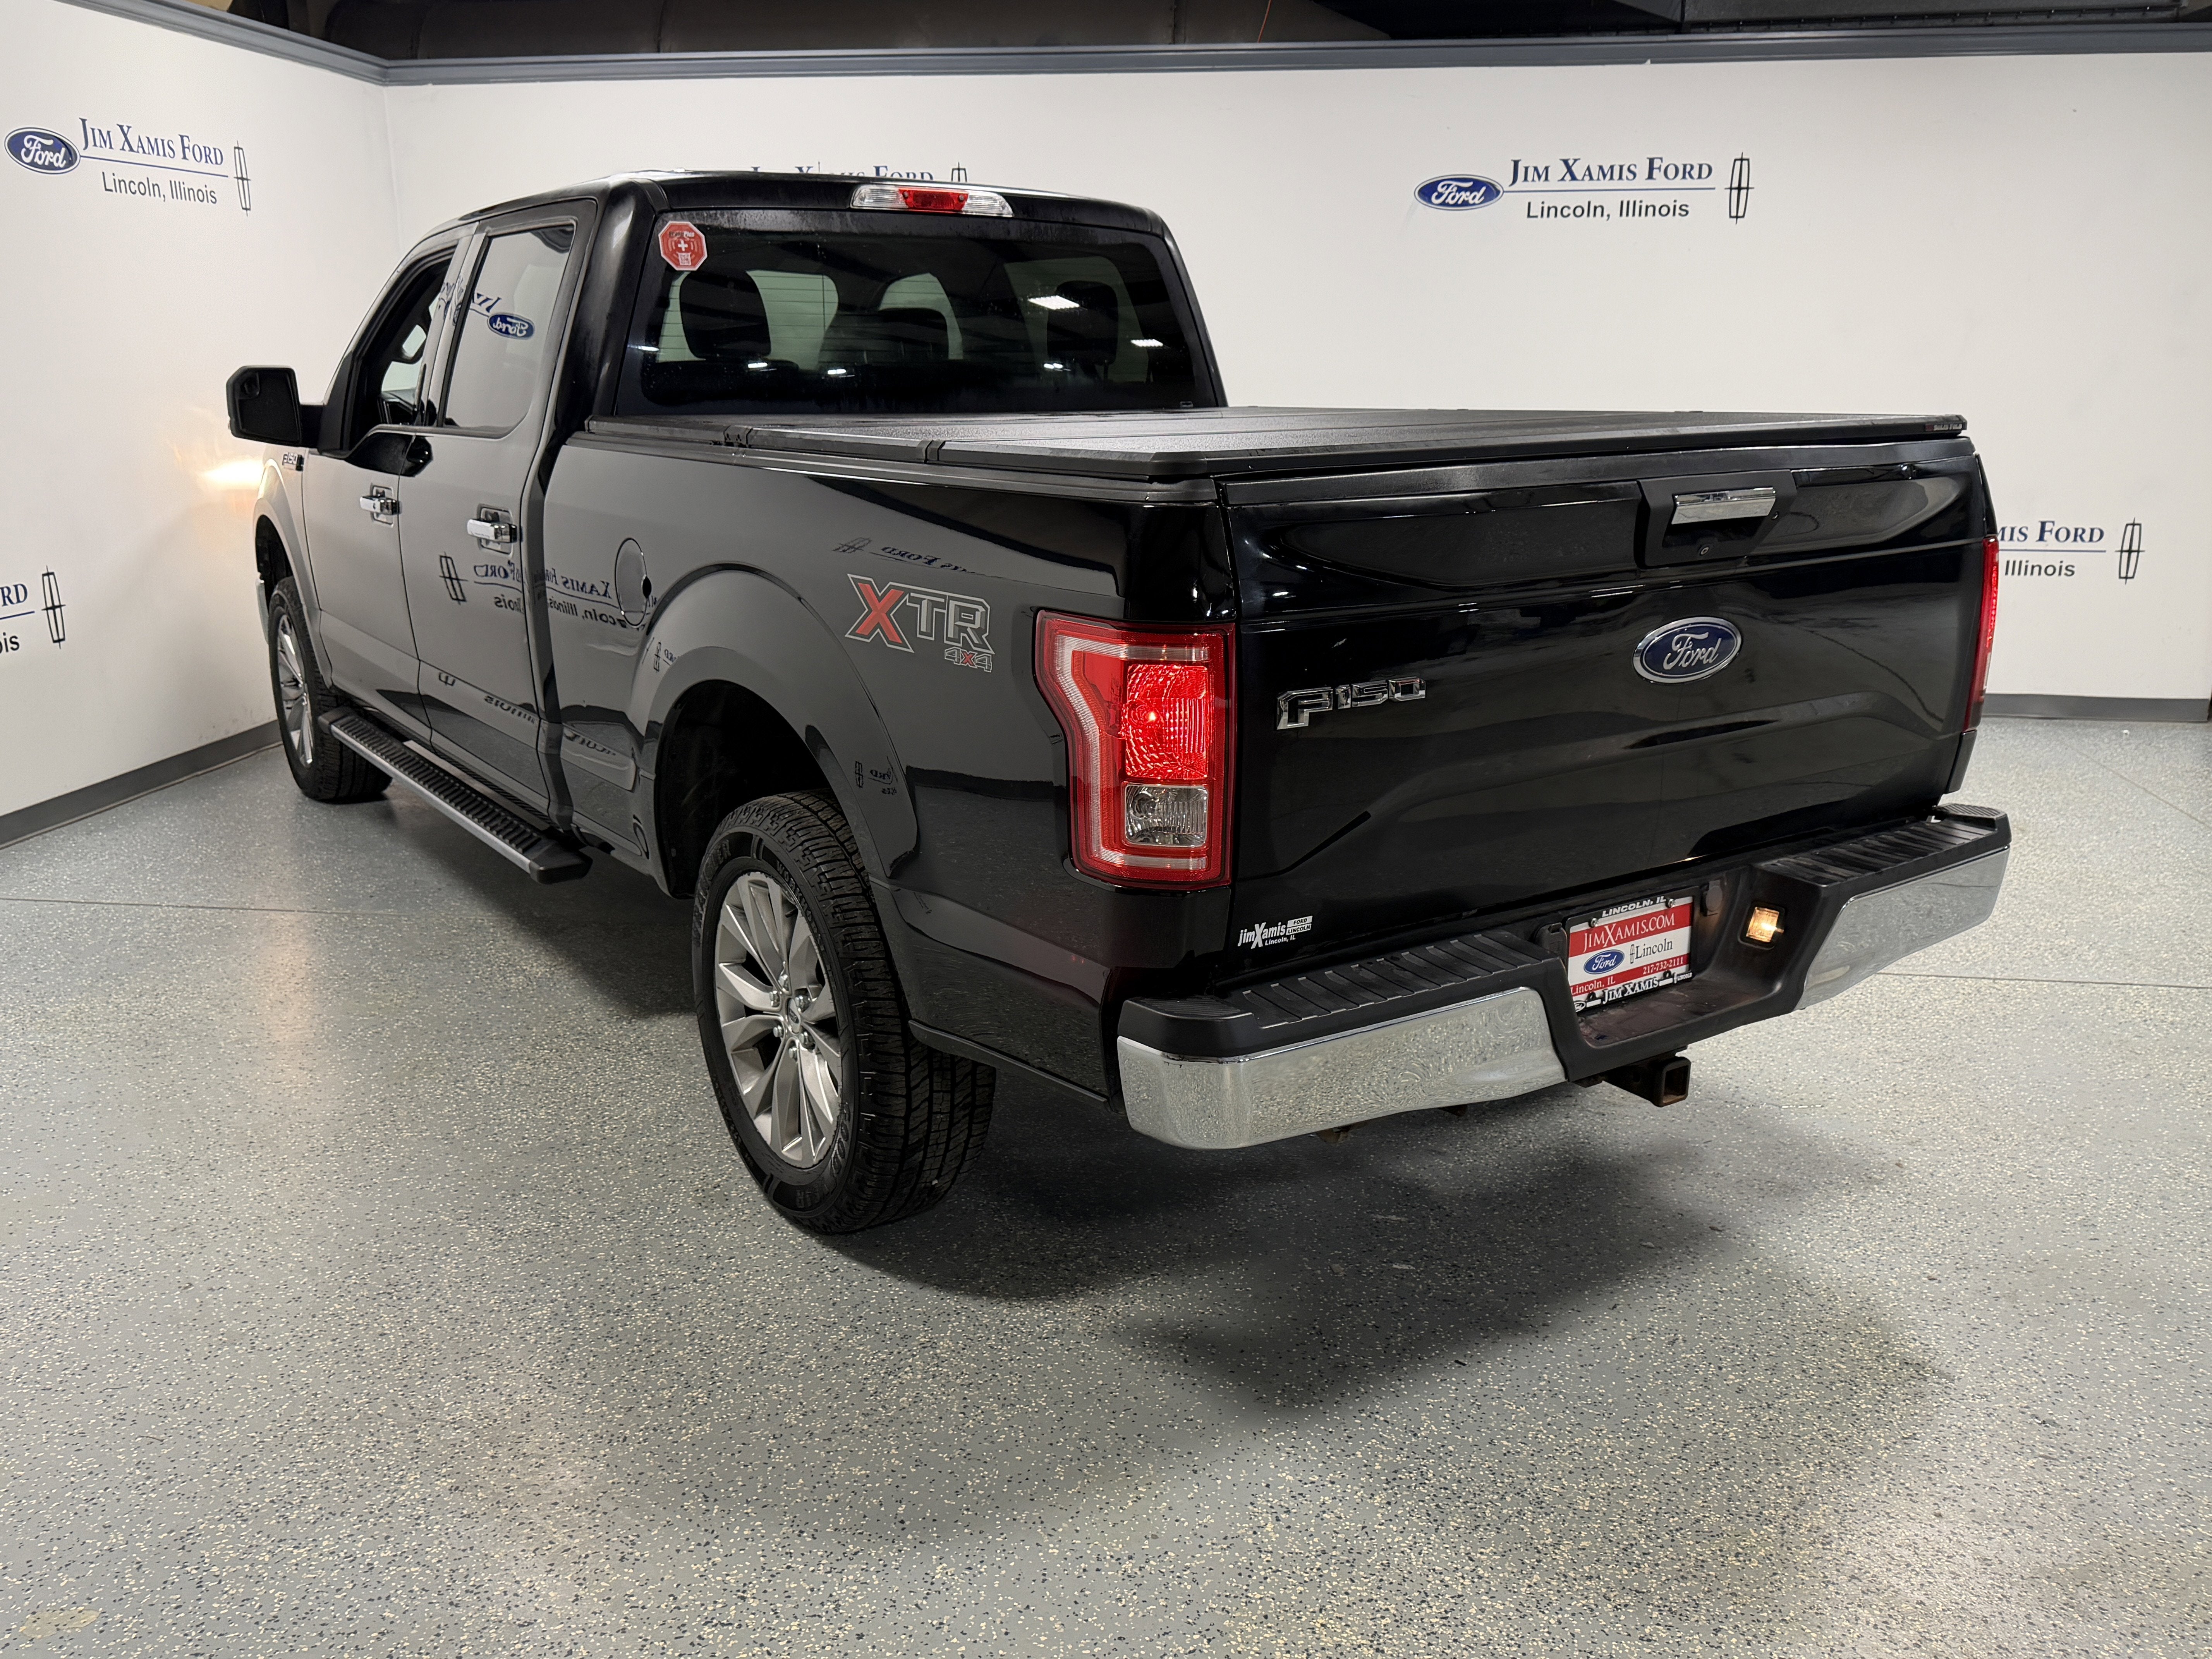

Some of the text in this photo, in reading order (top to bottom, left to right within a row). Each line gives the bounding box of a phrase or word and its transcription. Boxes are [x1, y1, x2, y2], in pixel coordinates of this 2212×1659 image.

[21, 134, 66, 168] Ford
[79, 117, 224, 166] JIM XAMIS FORD
[1508, 156, 1713, 187] JIM XAMIS FORD
[102, 171, 218, 204] Lincoln, Illinois
[1431, 180, 1486, 205] Ford
[1527, 199, 1690, 221] Lincoln, Illinois
[1997, 520, 2105, 543] MIS FORD
[2004, 560, 2076, 577] Illinois
[0, 583, 28, 607] RD
[845, 573, 995, 654] XTR
[1663, 630, 1719, 670] Ford
[1602, 896, 1666, 917] LINCOLN, IL
[1287, 925, 1311, 934] LINCOLN
[1293, 917, 1308, 926] FORD
[1265, 936, 1289, 946] Lincoln,
[1635, 938, 1673, 960] Lincoln
[1592, 953, 1616, 971] Ford
[1643, 957, 1683, 975] 217-732-2111
[1602, 978, 1659, 1005] JIM XAMIS
[1607, 976, 1616, 986] IL
